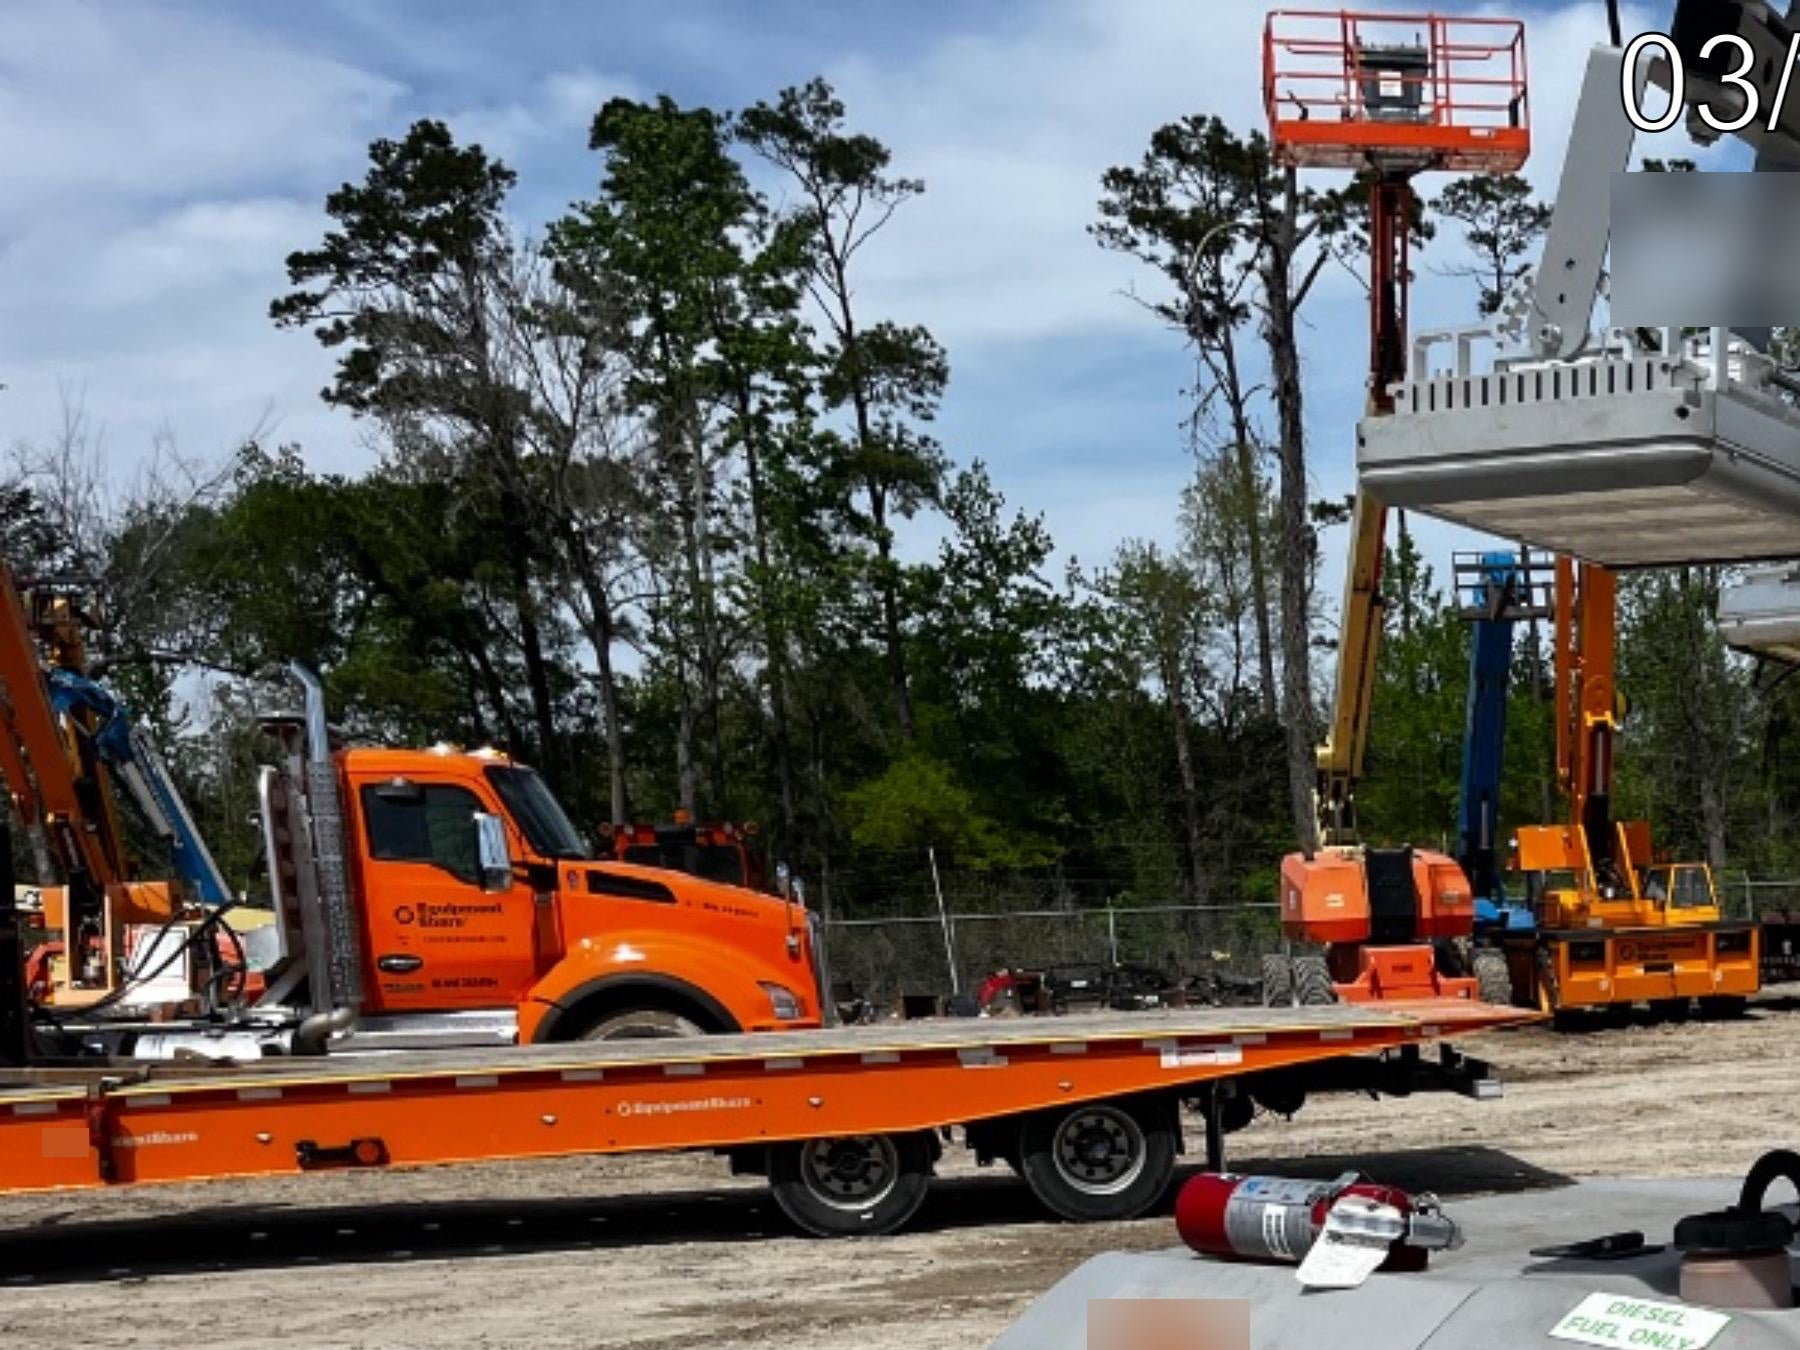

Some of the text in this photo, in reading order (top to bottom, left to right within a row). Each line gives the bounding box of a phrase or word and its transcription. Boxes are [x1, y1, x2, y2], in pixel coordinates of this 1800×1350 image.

[1605, 1301, 1688, 1327] DIESEL
[1562, 1316, 1697, 1350] FUEL ONLY
